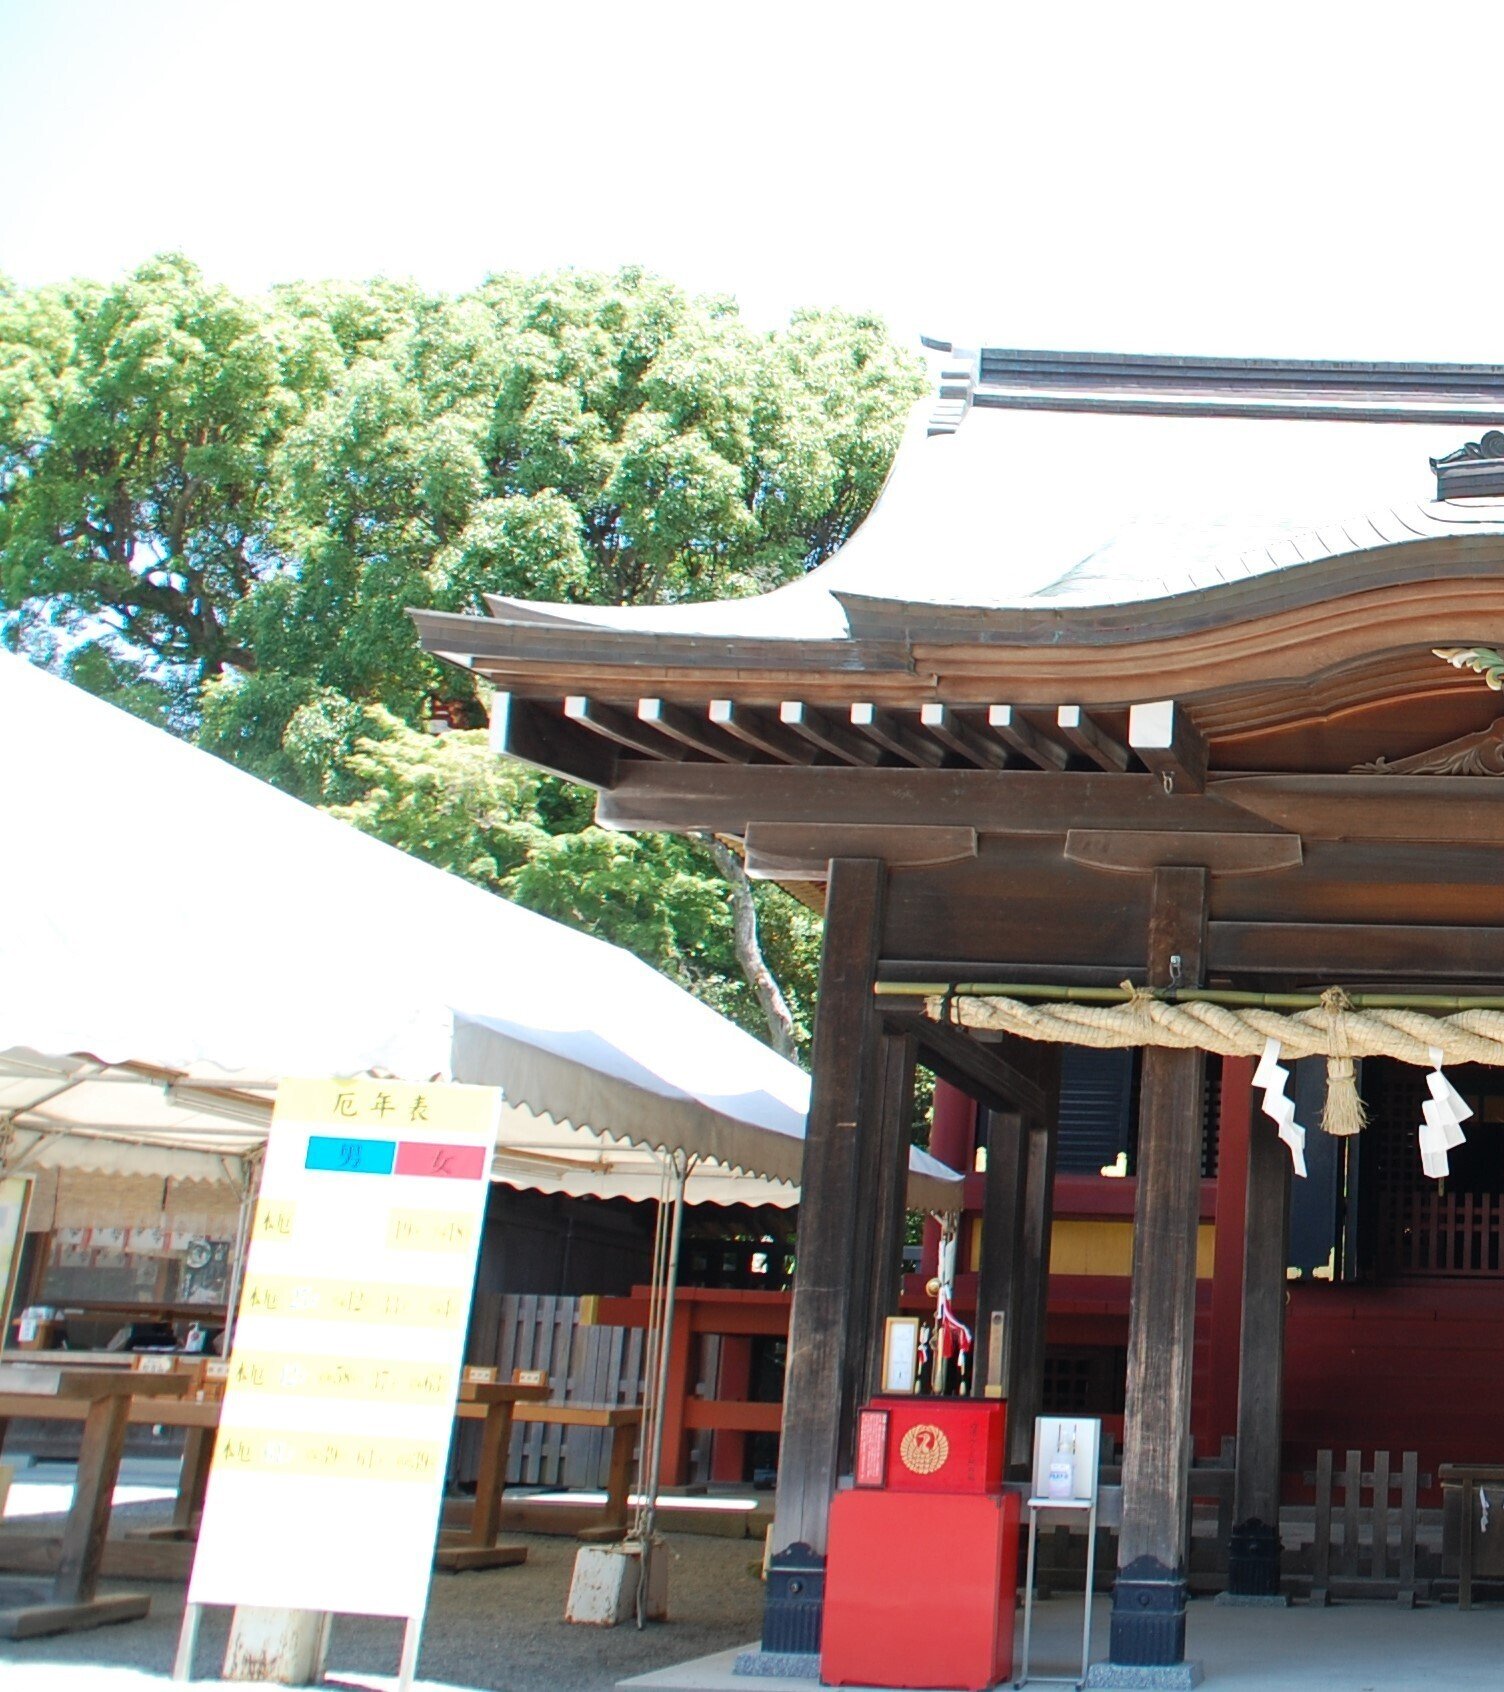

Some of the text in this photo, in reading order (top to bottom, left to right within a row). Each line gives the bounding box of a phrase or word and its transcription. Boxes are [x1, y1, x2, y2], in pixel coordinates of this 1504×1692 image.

[333, 1091, 428, 1122] 厄年表
[339, 1142, 455, 1174] 男 女
